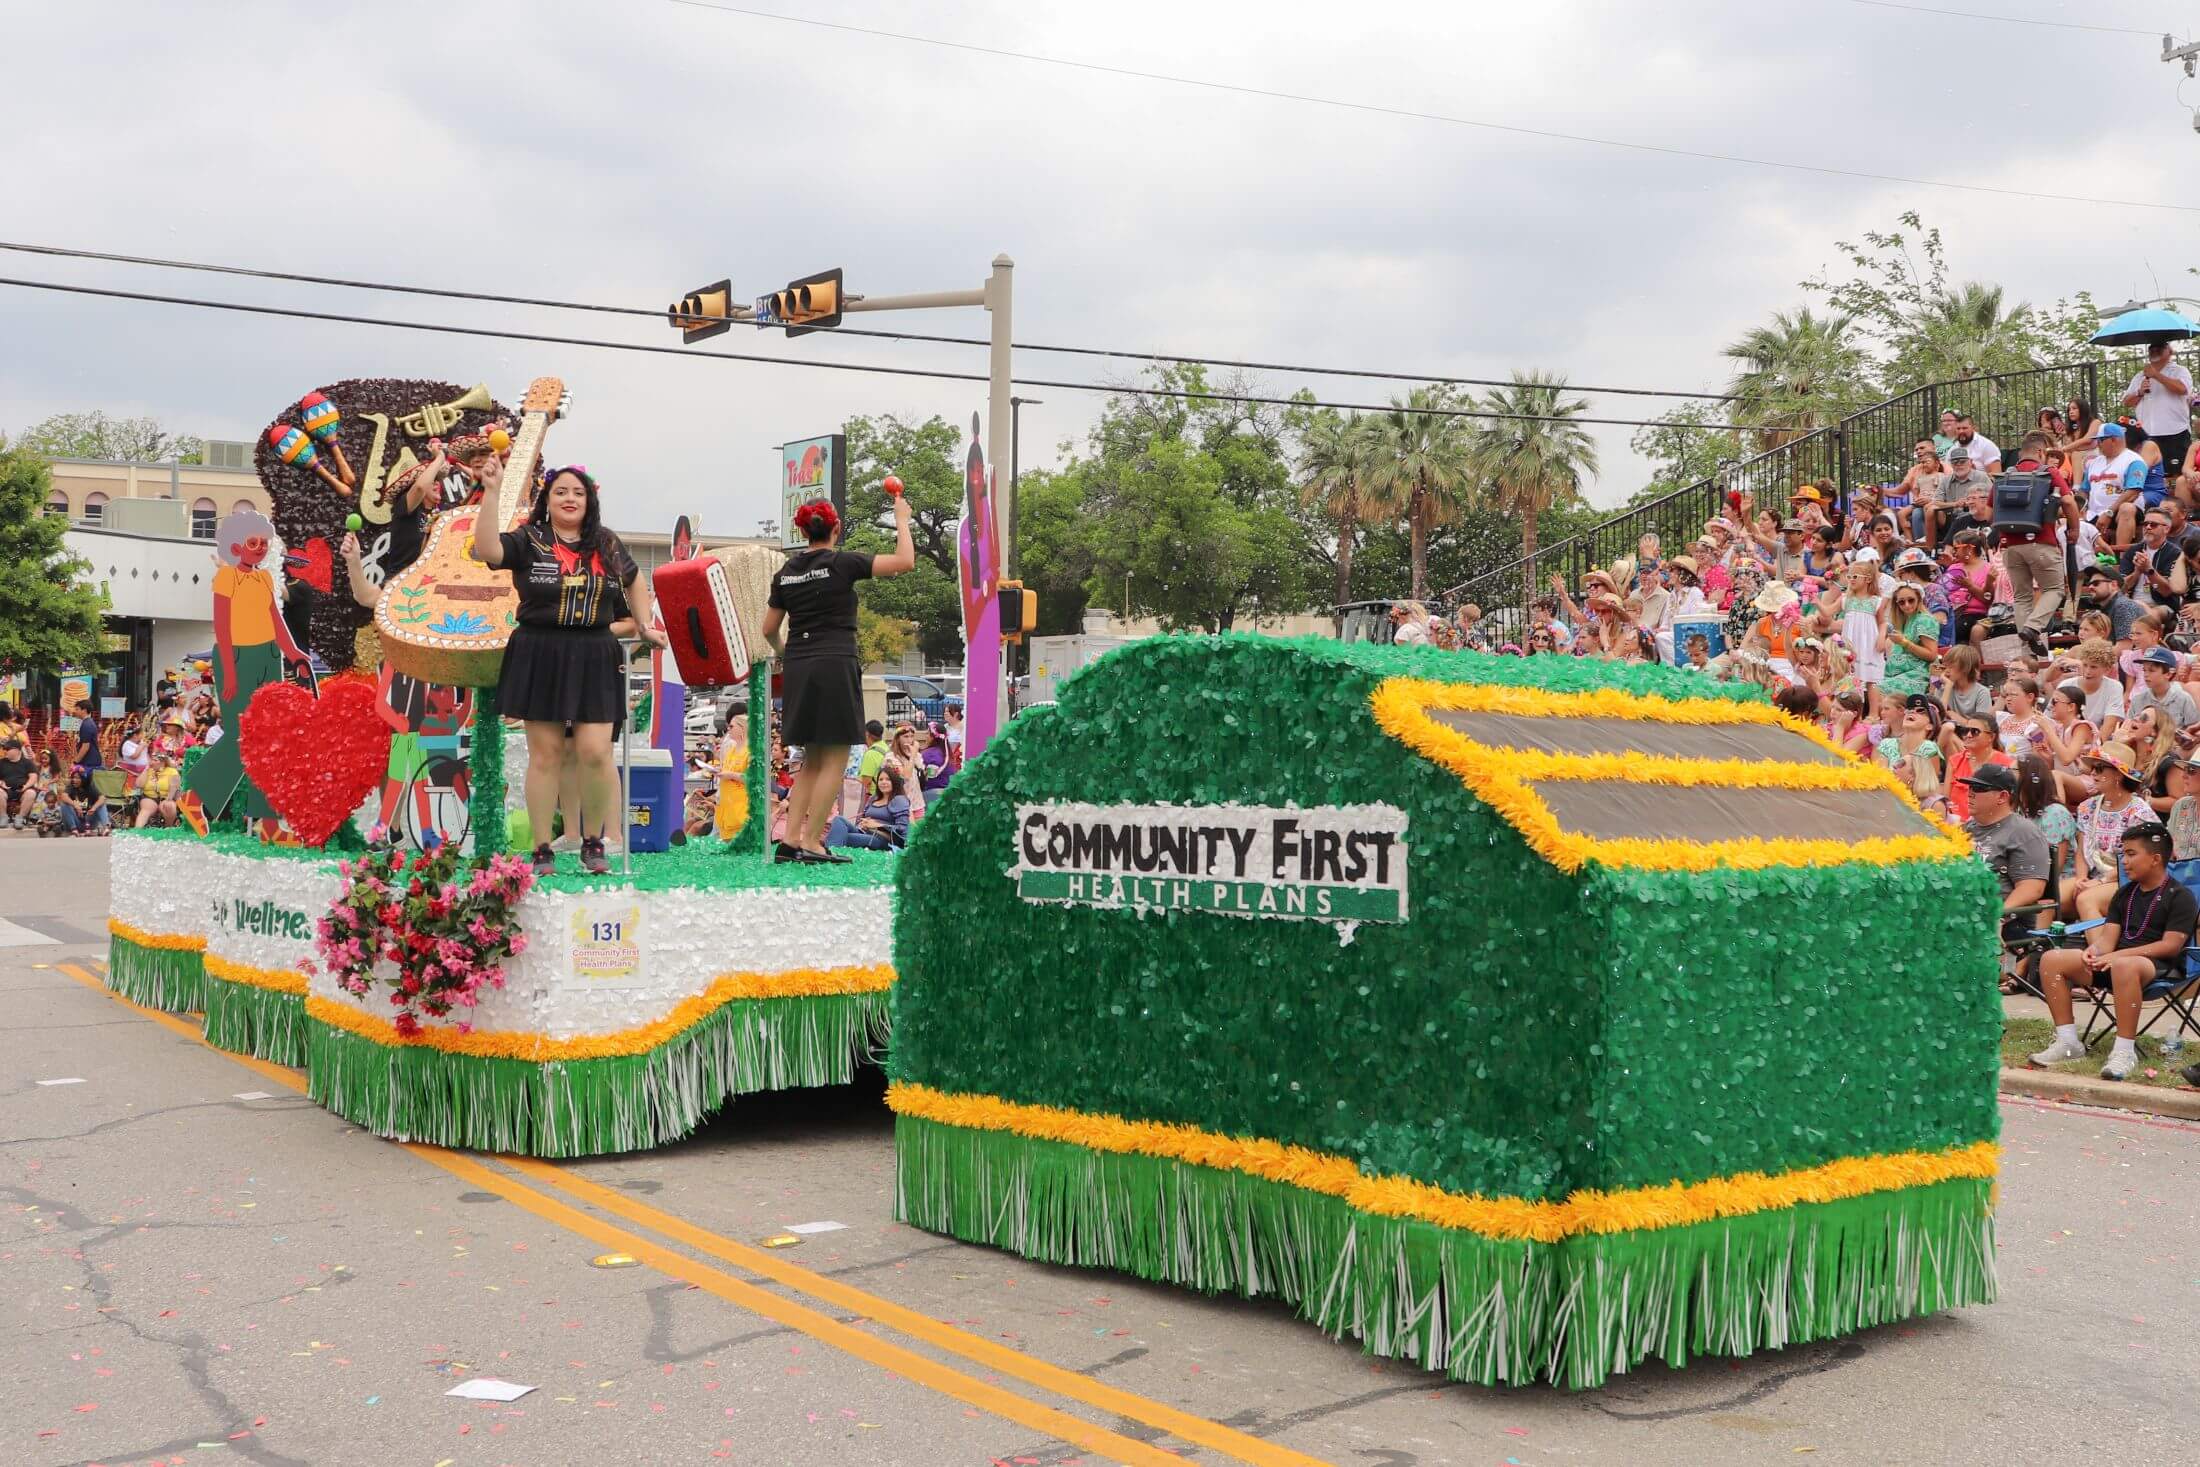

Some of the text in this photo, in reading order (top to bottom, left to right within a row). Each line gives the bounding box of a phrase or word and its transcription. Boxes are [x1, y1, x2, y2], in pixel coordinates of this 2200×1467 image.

[1022, 812, 1395, 884] COMMUNITY FIRST
[1068, 875, 1332, 915] HEALTH PLANS
[592, 922, 621, 941] 131
[572, 948, 640, 957] Community First
[580, 960, 632, 968] Health Plans
